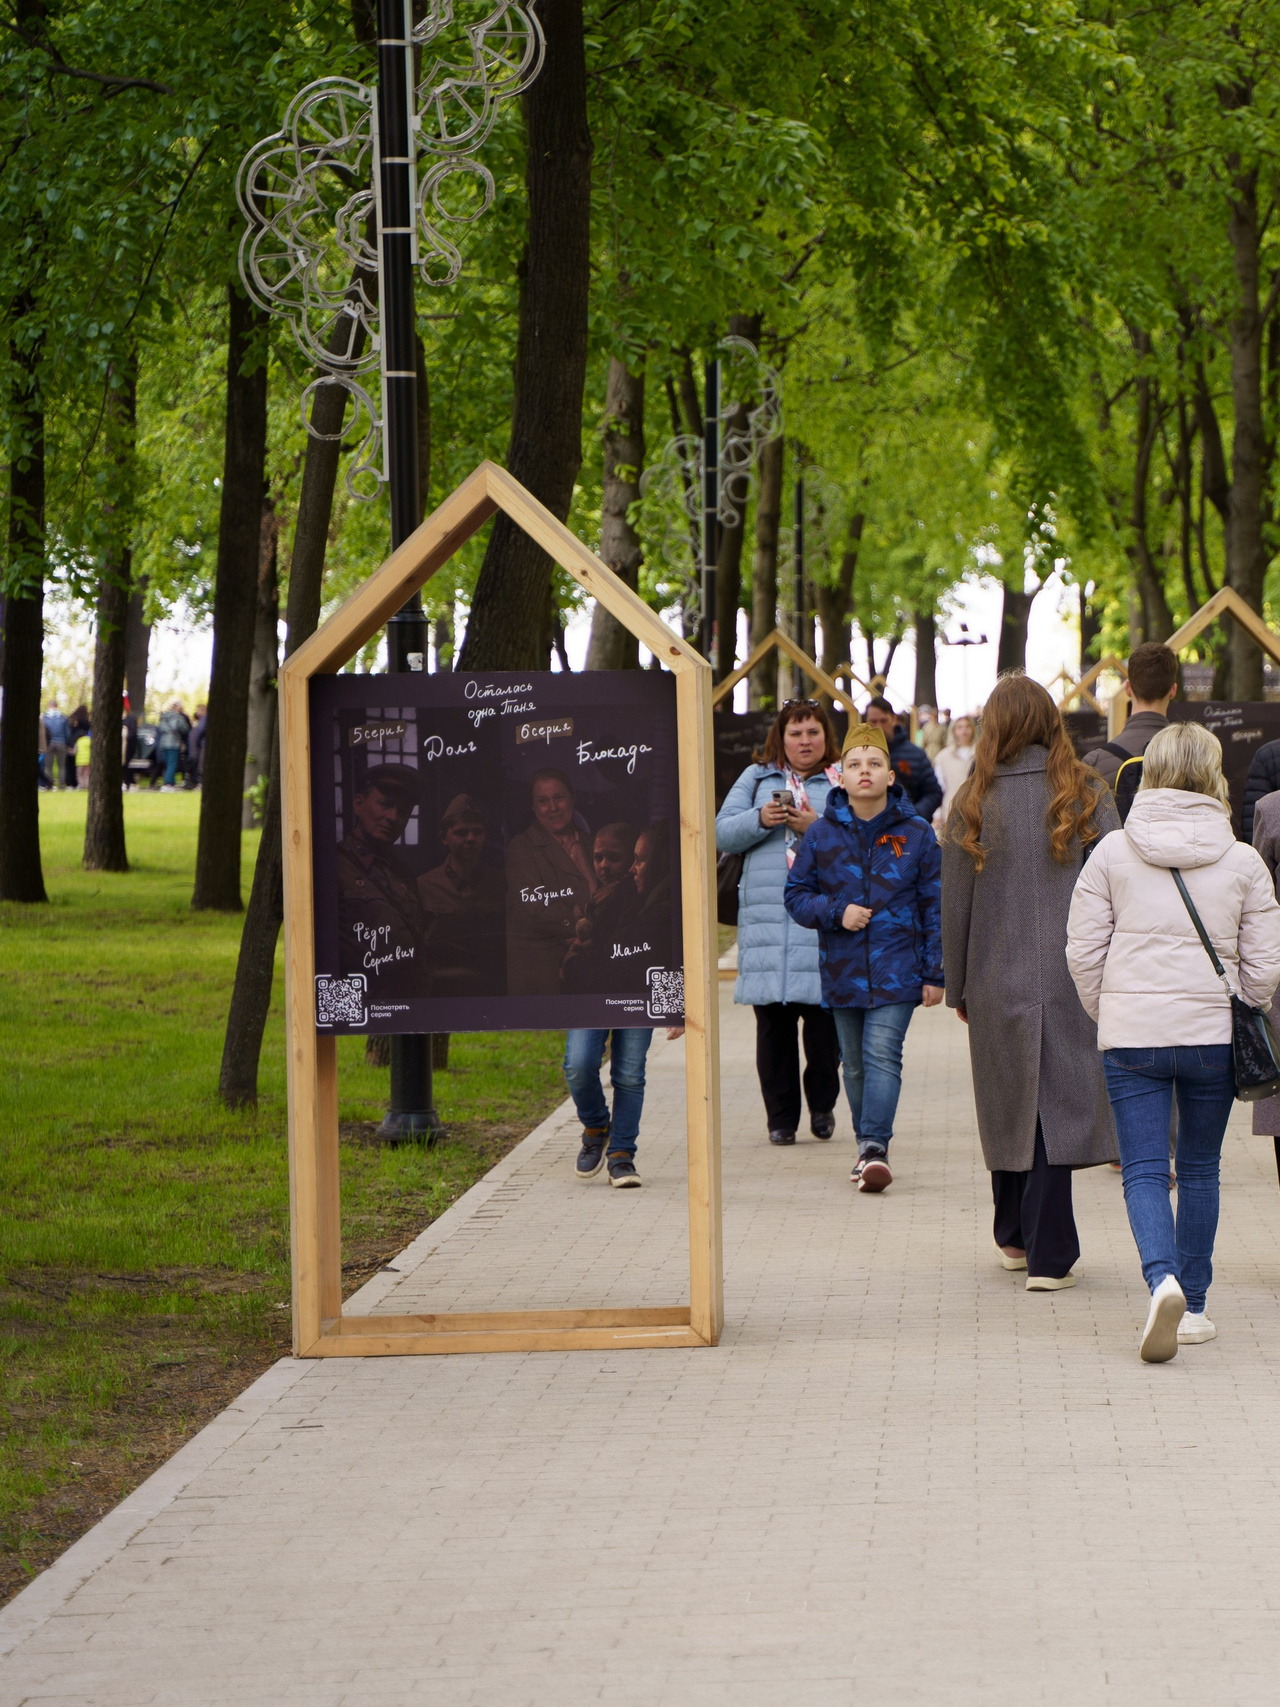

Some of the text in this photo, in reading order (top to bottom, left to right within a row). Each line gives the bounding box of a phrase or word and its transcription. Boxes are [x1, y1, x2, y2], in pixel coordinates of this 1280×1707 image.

[463, 679, 534, 700] Осталась
[467, 699, 537, 728] одна Таня
[424, 734, 478, 761] Долг
[576, 740, 653, 775] Блокада
[520, 885, 574, 907] Бабушка
[352, 921, 391, 952] Фёдор
[610, 941, 652, 960] Мама
[370, 1004, 410, 1012] Посмотреть
[605, 998, 645, 1006] Посмотреть
